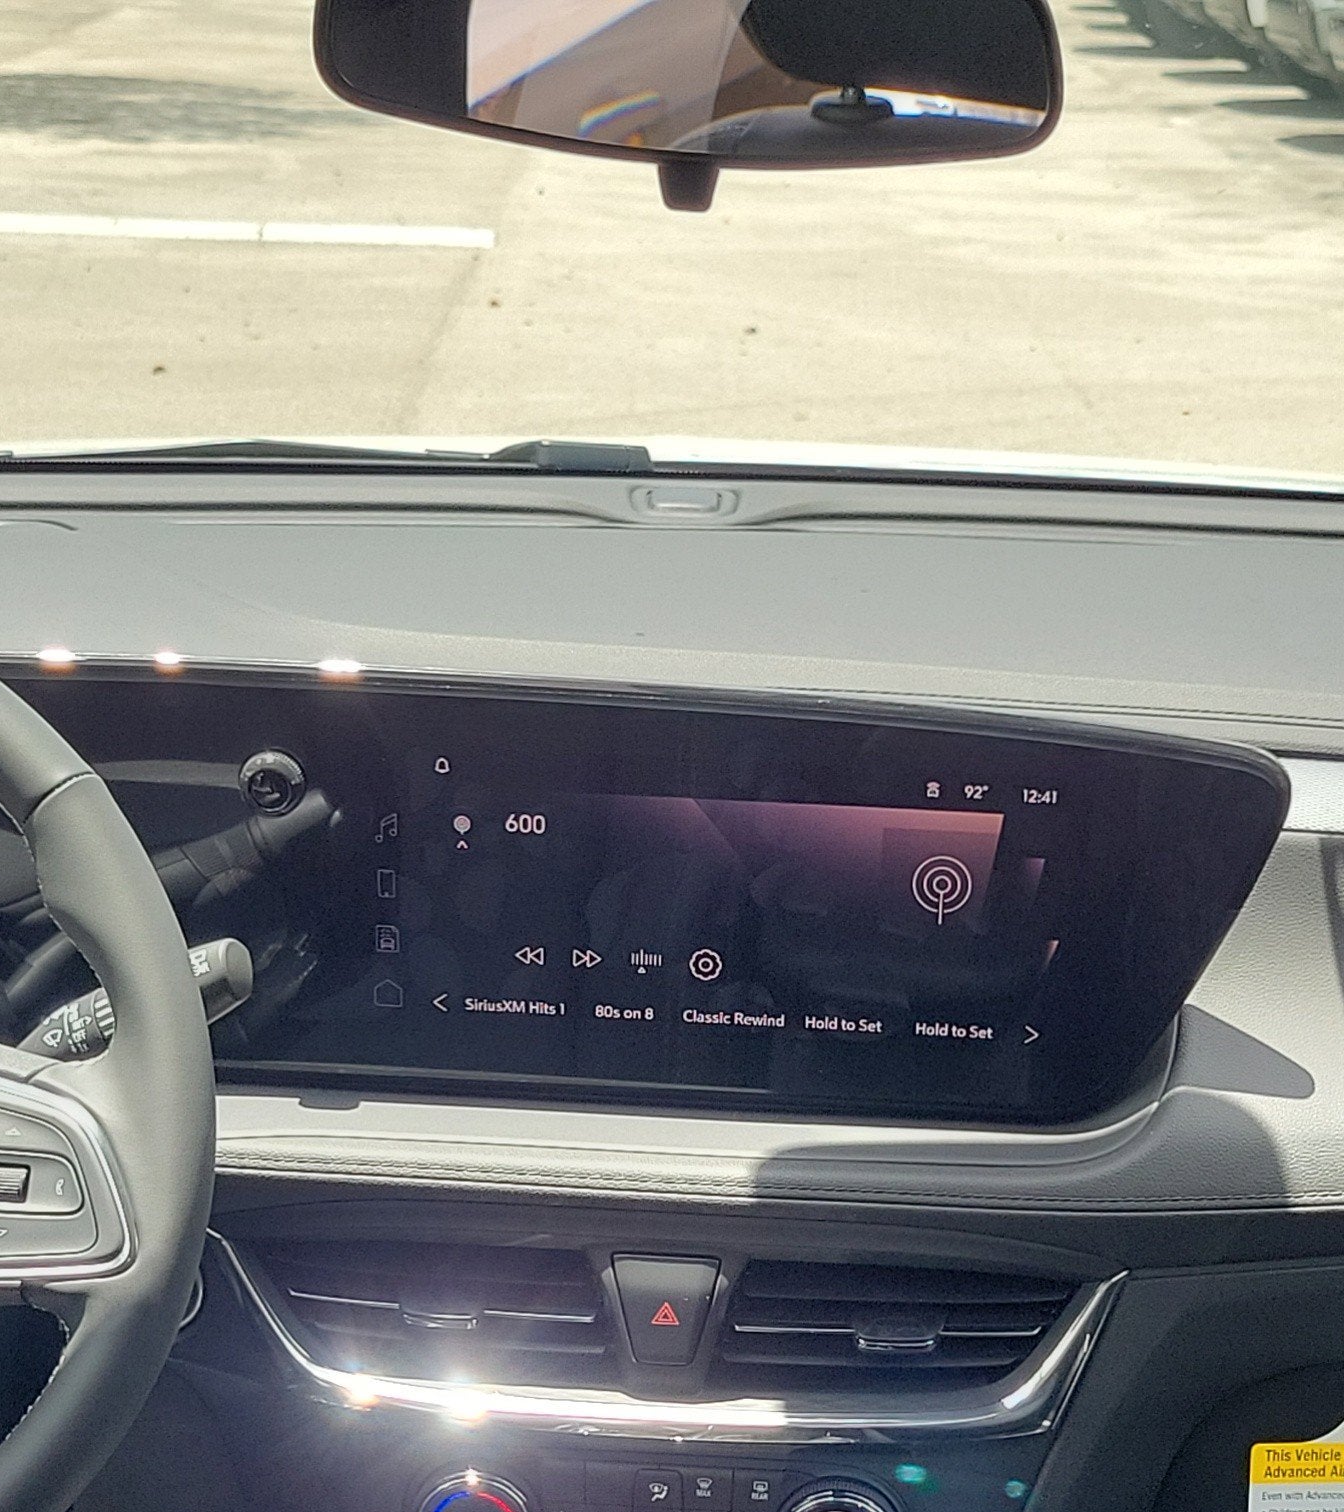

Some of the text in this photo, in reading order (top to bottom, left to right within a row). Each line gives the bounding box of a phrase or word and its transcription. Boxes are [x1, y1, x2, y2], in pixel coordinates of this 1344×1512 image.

[1022, 788, 1058, 804] 12:41
[504, 813, 547, 835] 600
[464, 997, 565, 1016] SiriusXM Hits 1
[594, 1005, 654, 1020] 80s on 8
[682, 1009, 786, 1028] Classic Rewind
[804, 1016, 884, 1034] Hold to Set
[914, 1022, 994, 1040] Hold to Set
[1265, 1449, 1292, 1462] This
[1295, 1449, 1341, 1462] Vehicle
[1264, 1465, 1326, 1478] Advanced
[1261, 1491, 1283, 1501] Even
